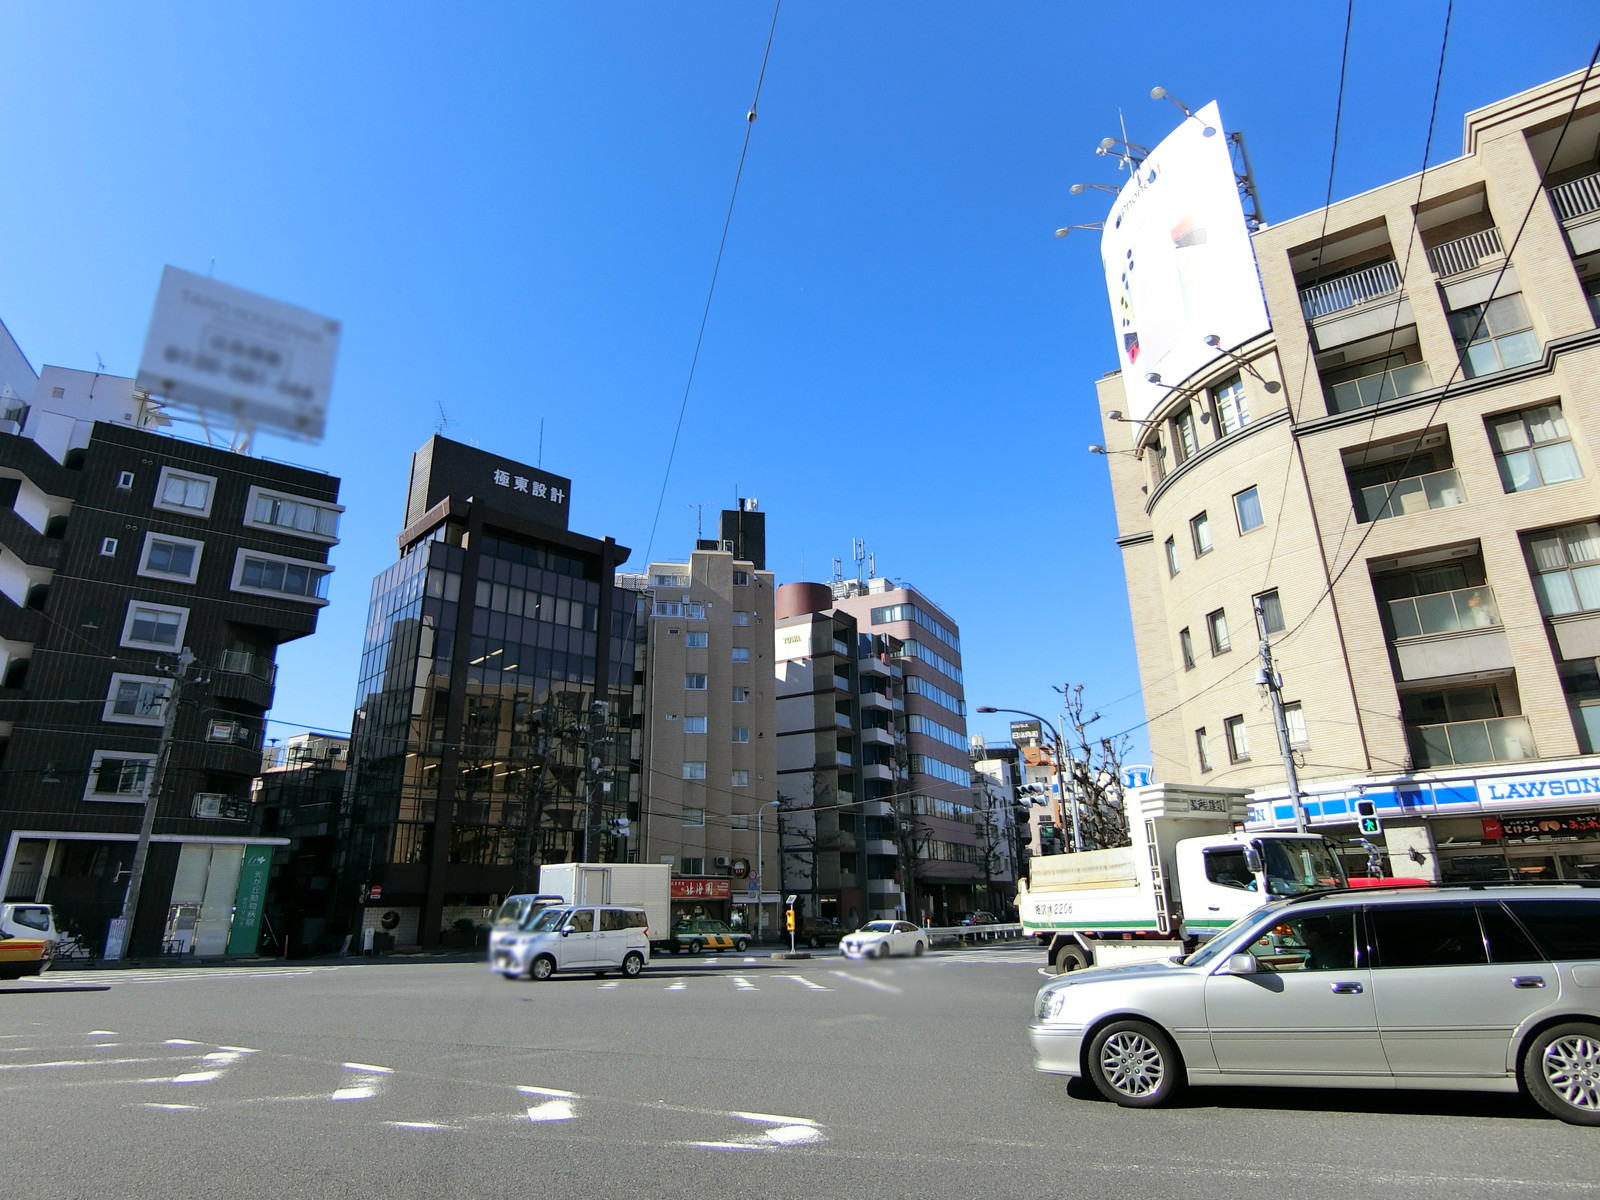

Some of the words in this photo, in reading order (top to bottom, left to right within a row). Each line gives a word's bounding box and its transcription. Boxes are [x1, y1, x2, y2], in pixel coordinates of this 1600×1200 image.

[493, 468, 565, 504] 極東設計
[1488, 777, 1600, 800] LAWSON
